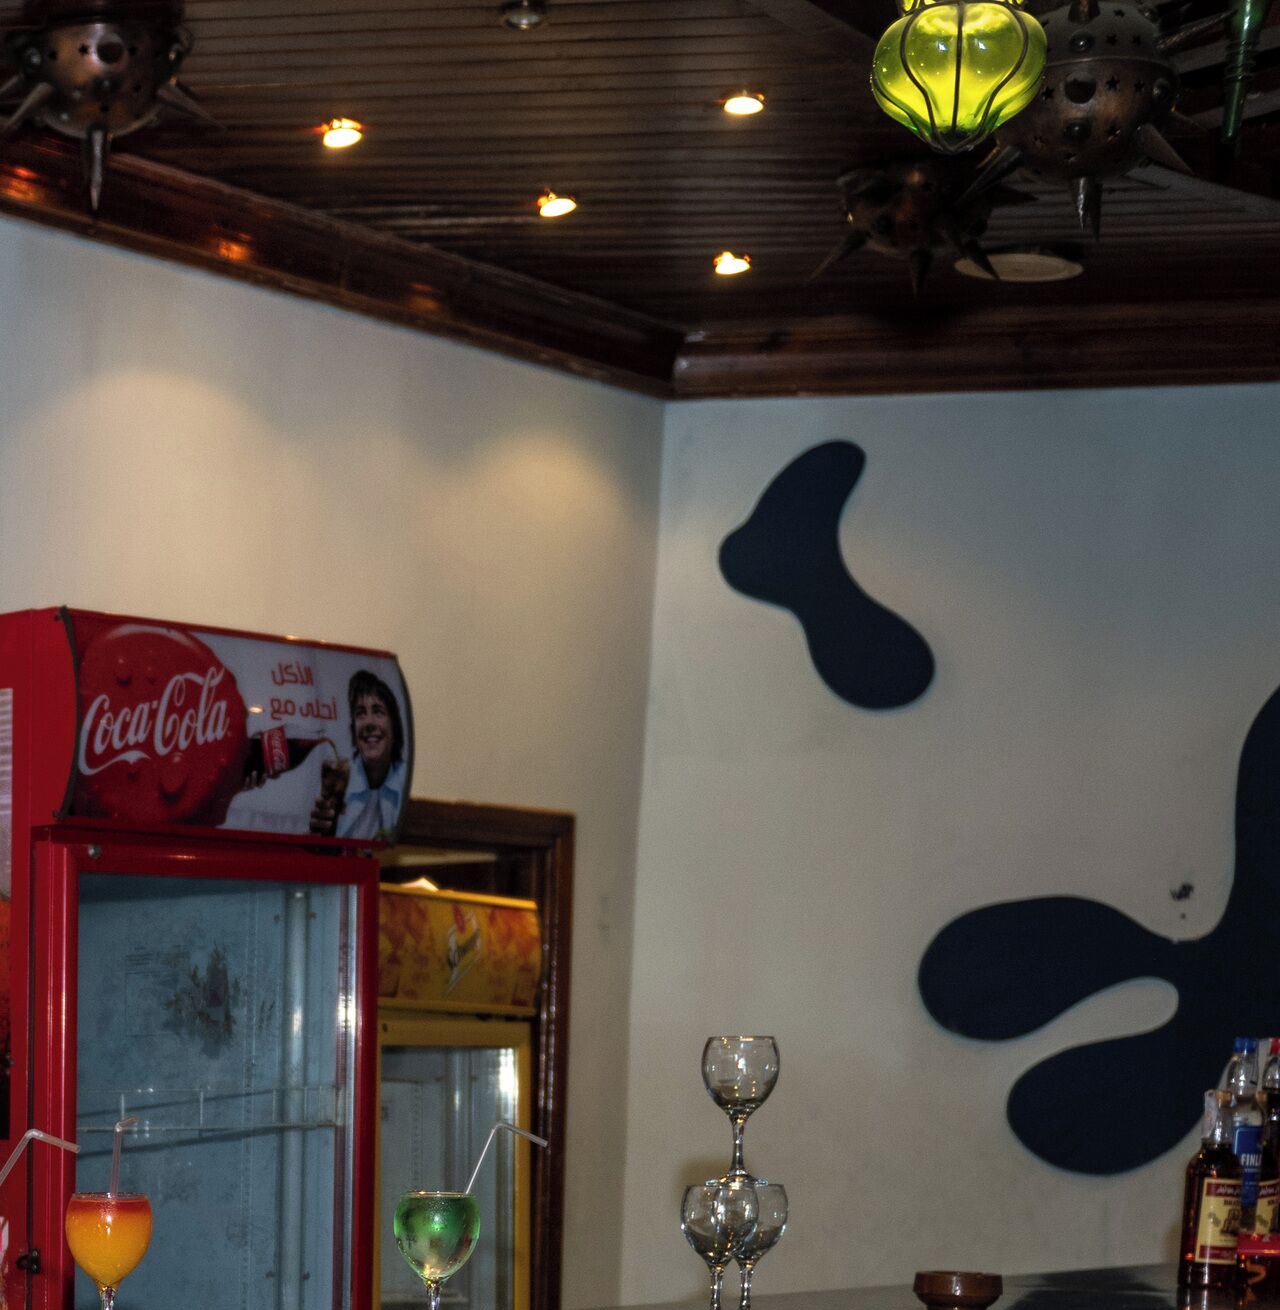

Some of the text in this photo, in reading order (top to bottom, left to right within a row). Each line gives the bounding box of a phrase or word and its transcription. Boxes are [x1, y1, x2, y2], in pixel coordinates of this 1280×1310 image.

[271, 661, 313, 685] الأكل
[78, 666, 229, 775] Coca-Cola
[270, 698, 295, 720] مع
